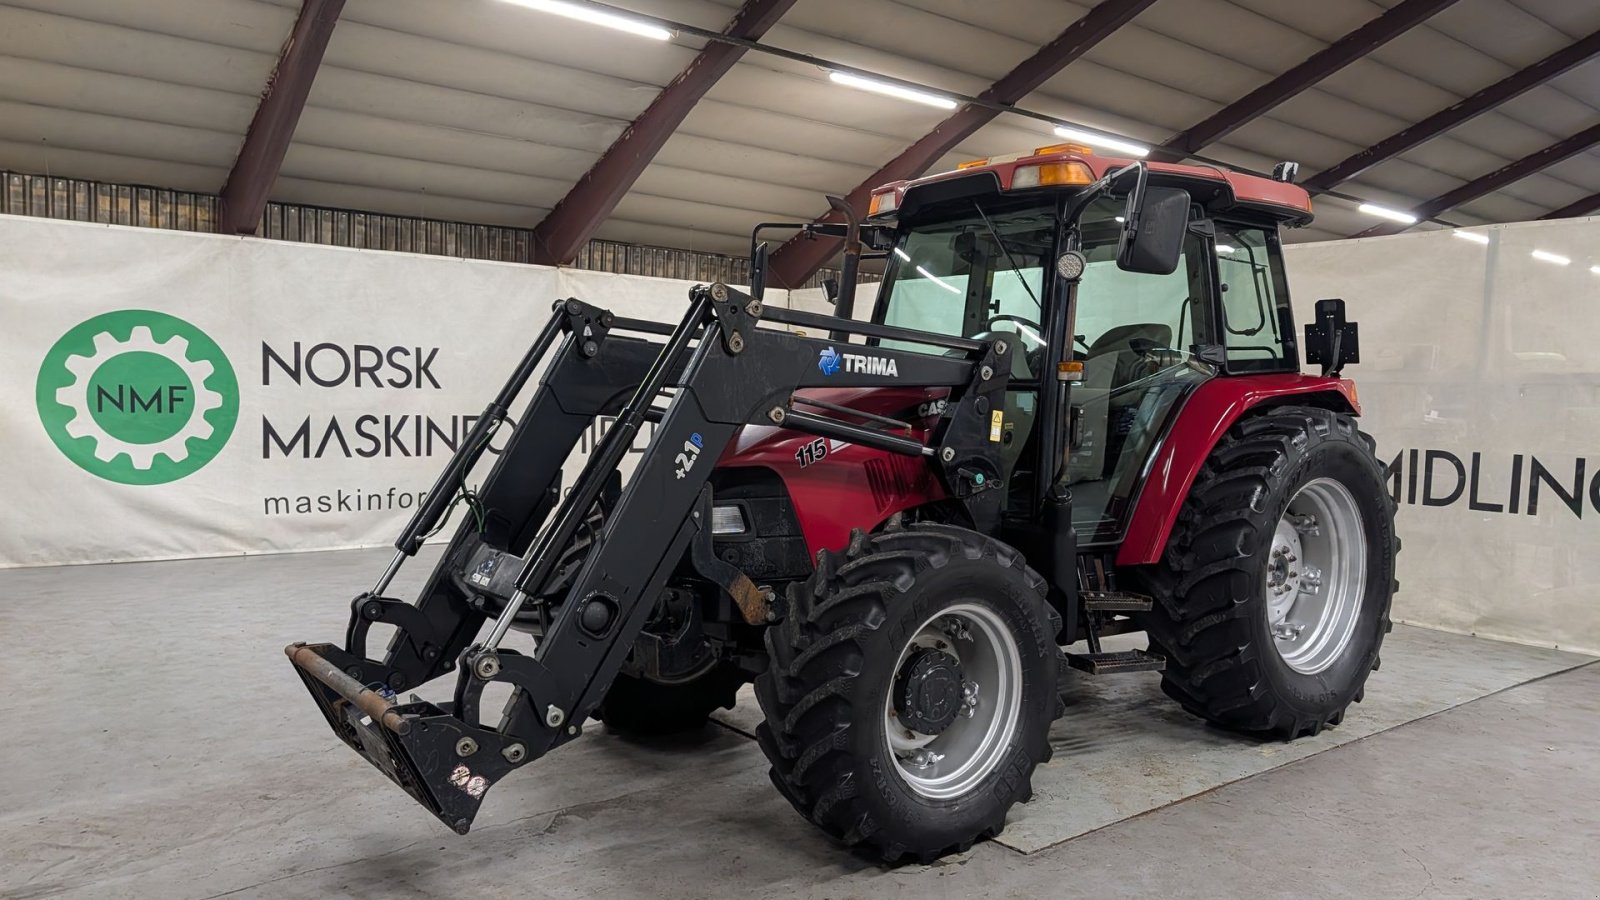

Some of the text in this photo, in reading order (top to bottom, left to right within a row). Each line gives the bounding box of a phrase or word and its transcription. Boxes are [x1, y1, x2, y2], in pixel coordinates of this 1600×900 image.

[262, 340, 442, 389] NORSK
[842, 353, 899, 377] TRIMA
[97, 384, 187, 413] NMF
[918, 400, 947, 417] CAS
[794, 437, 828, 470] 115
